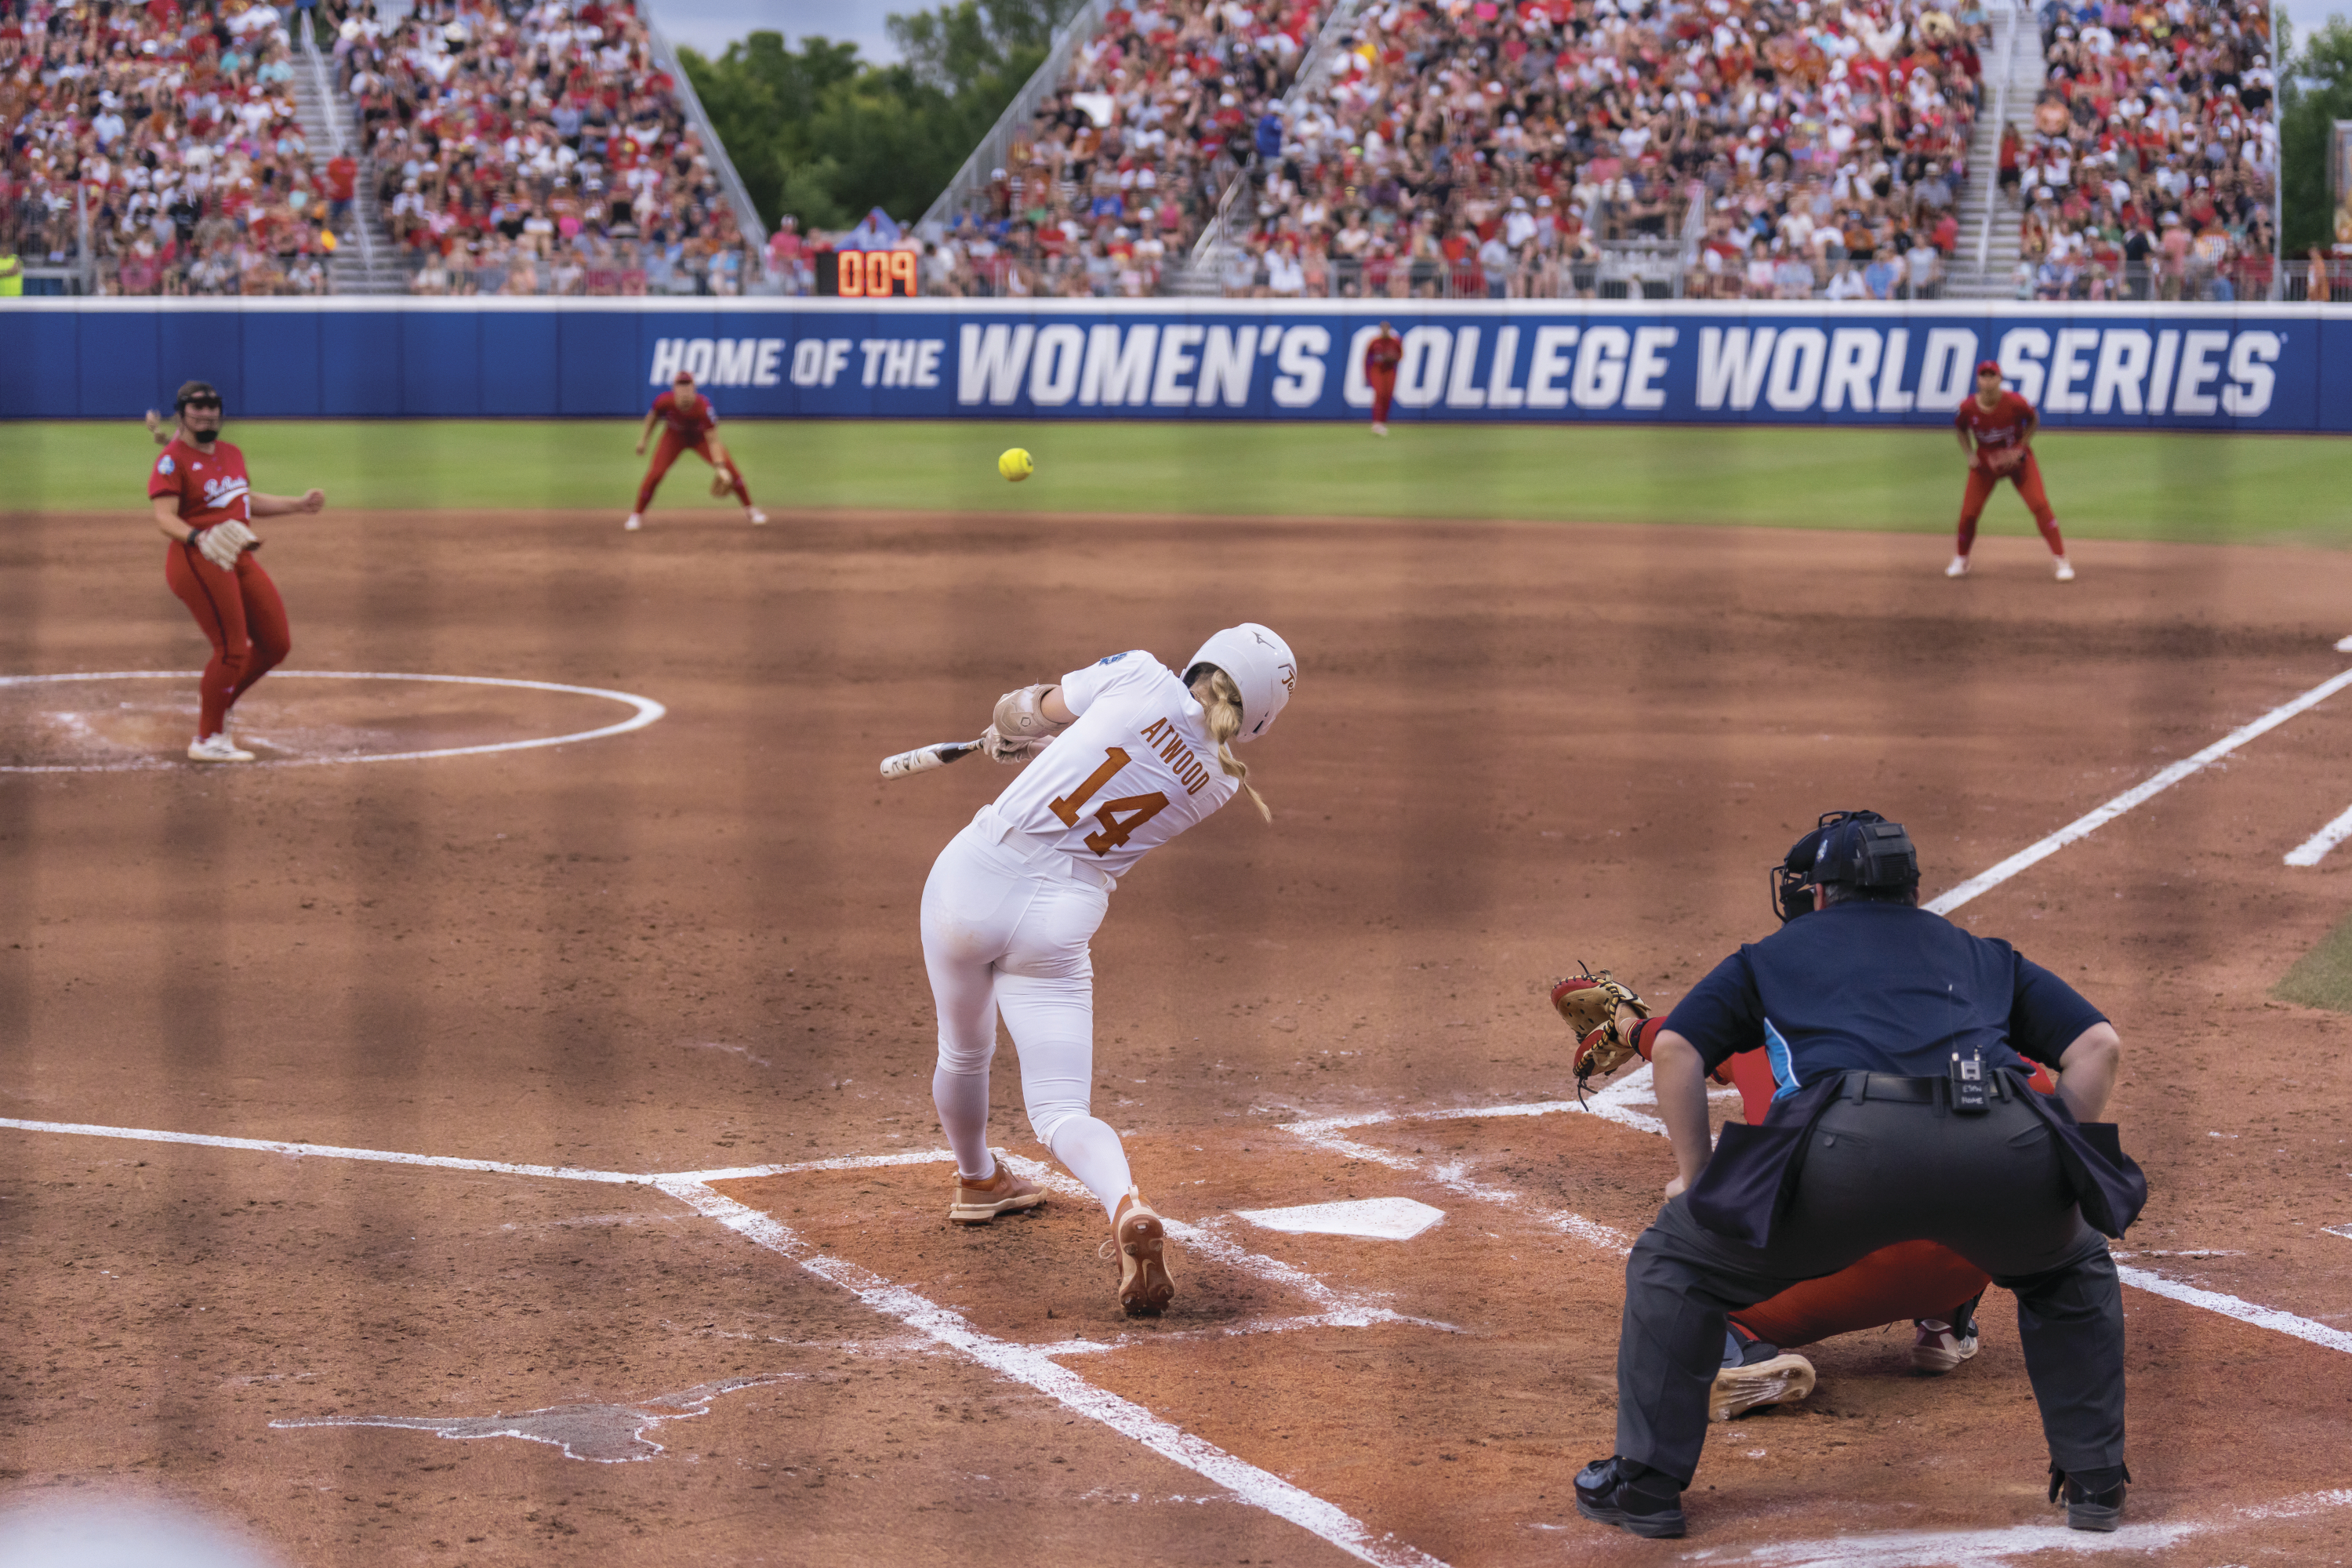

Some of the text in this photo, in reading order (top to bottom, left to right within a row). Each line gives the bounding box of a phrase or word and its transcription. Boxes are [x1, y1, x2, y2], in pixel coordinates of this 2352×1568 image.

[838, 249, 916, 297] 009
[649, 338, 785, 386] HOME
[790, 338, 852, 386] OF
[861, 338, 945, 387] THE
[957, 323, 1331, 407] WOMEN'S
[1343, 325, 1679, 408] COLLEGE
[1695, 325, 1979, 412] WORLD
[1140, 717, 1210, 796] ATWOOD
[1047, 746, 1171, 858] 14
[1962, 1096, 1984, 1105] HOME
